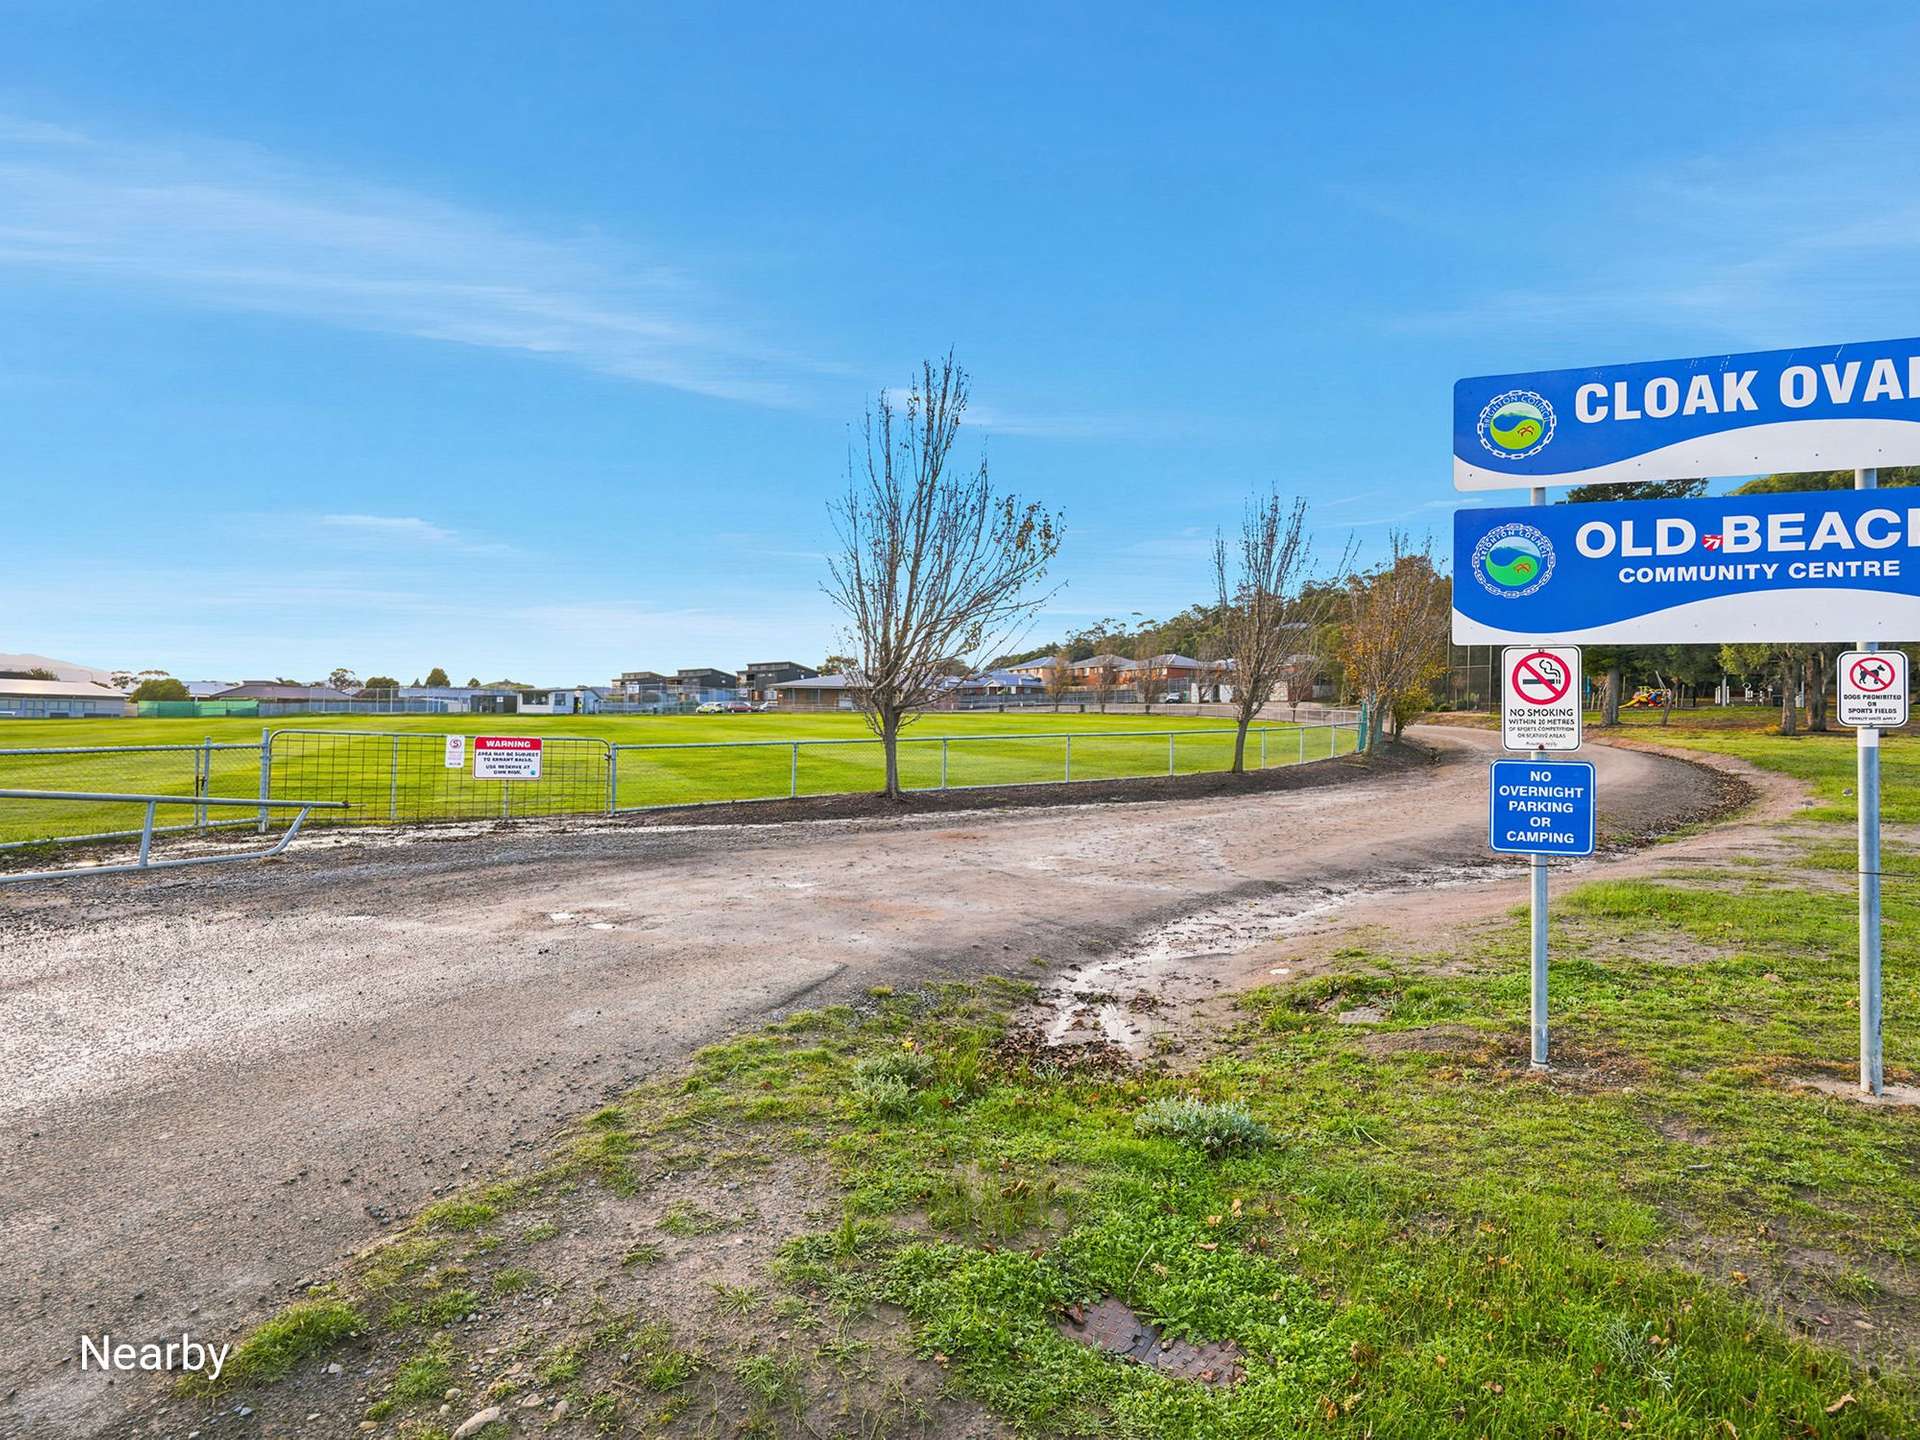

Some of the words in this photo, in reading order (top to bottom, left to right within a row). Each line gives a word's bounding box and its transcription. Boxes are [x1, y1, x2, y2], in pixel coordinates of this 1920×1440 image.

[1575, 369, 1760, 424] CLOAK
[1575, 517, 1698, 559] OLD
[1722, 508, 1920, 554] BEAC
[1618, 563, 1780, 584] COMMUNITY
[1788, 560, 1901, 579] CENTRE
[1509, 708, 1525, 717] NO
[1527, 708, 1574, 717] SMOKING
[485, 740, 531, 748] WARNING
[1530, 770, 1552, 782] NO
[1499, 785, 1585, 798] OVERNIGHT
[1508, 800, 1574, 814] PARKING
[1529, 816, 1551, 827] OR
[1506, 830, 1575, 844] CAMPING
